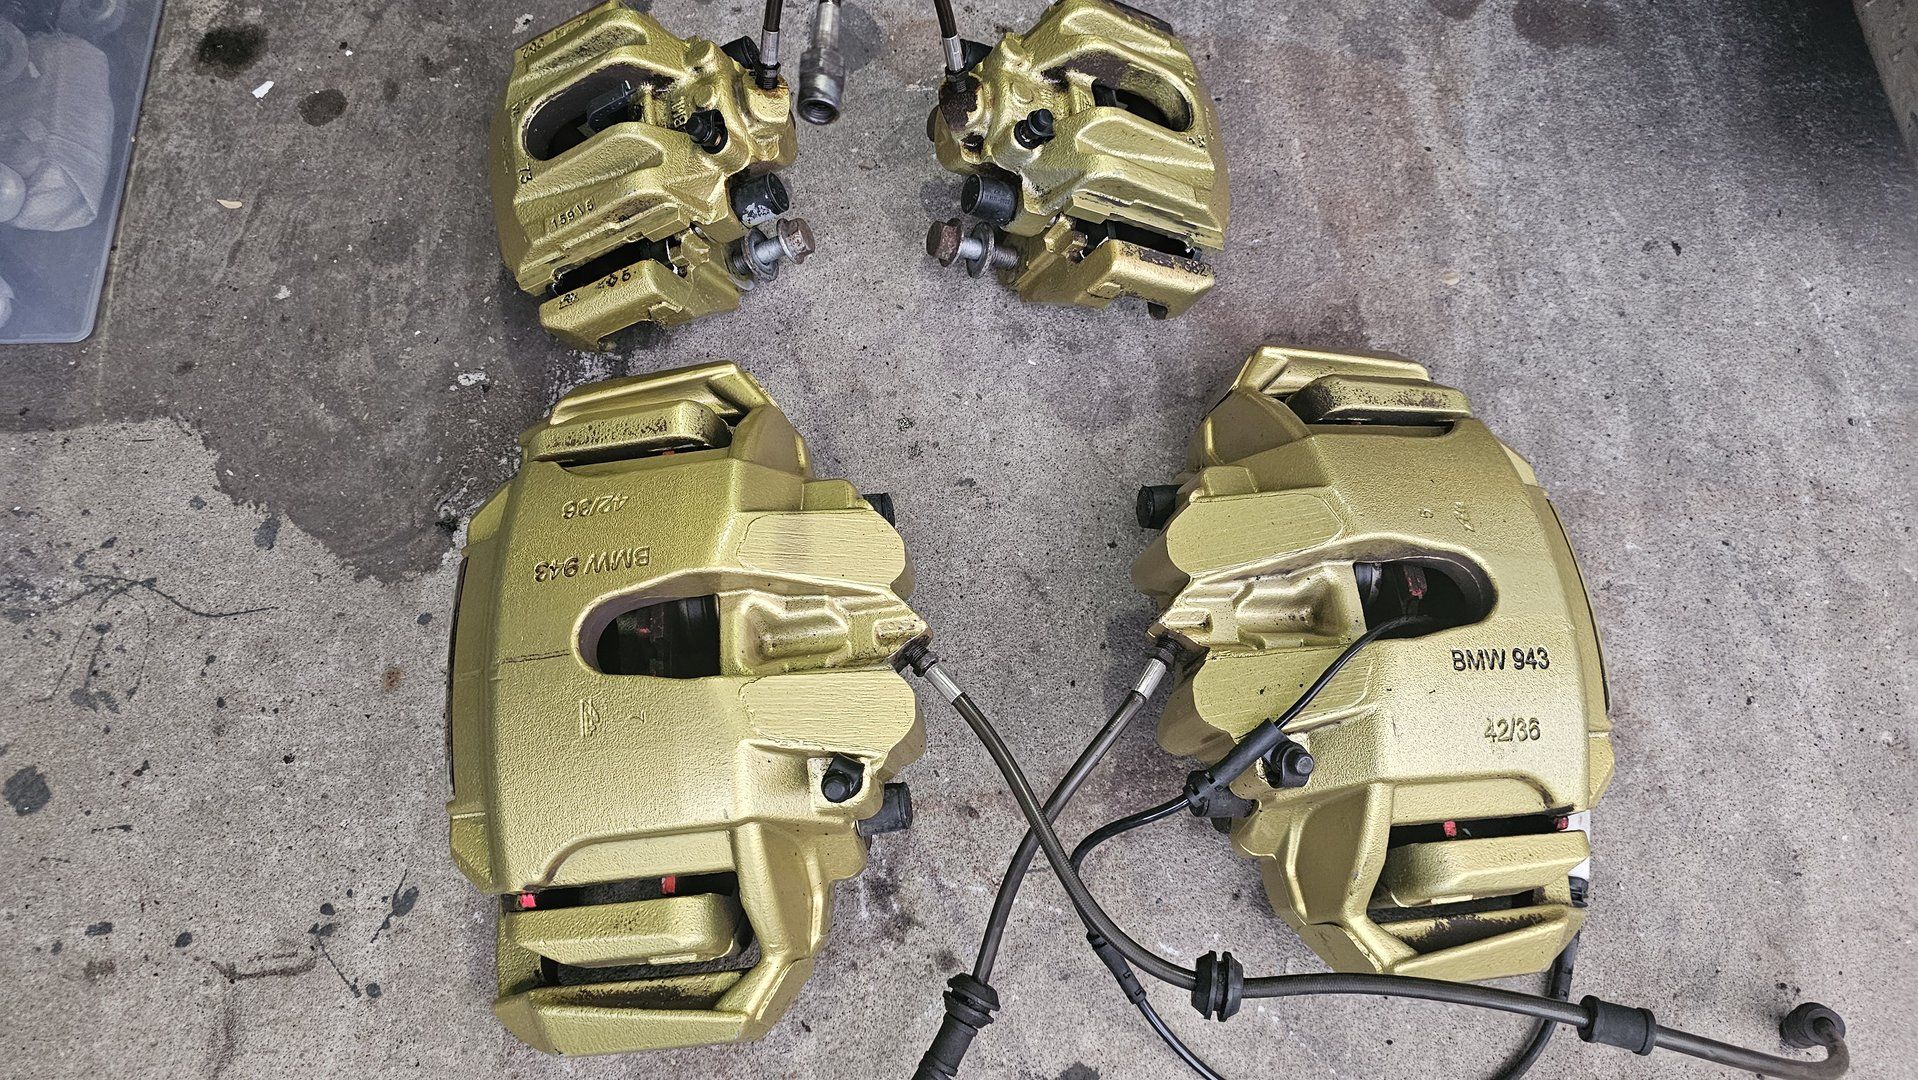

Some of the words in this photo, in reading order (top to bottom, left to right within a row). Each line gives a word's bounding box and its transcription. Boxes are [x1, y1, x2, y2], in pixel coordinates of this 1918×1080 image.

[563, 493, 628, 519] 42/36
[534, 557, 579, 583] 943
[585, 547, 650, 575] BMW
[1452, 647, 1506, 671] BMW
[1512, 646, 1550, 670] 943
[1484, 716, 1541, 743] 42/36
